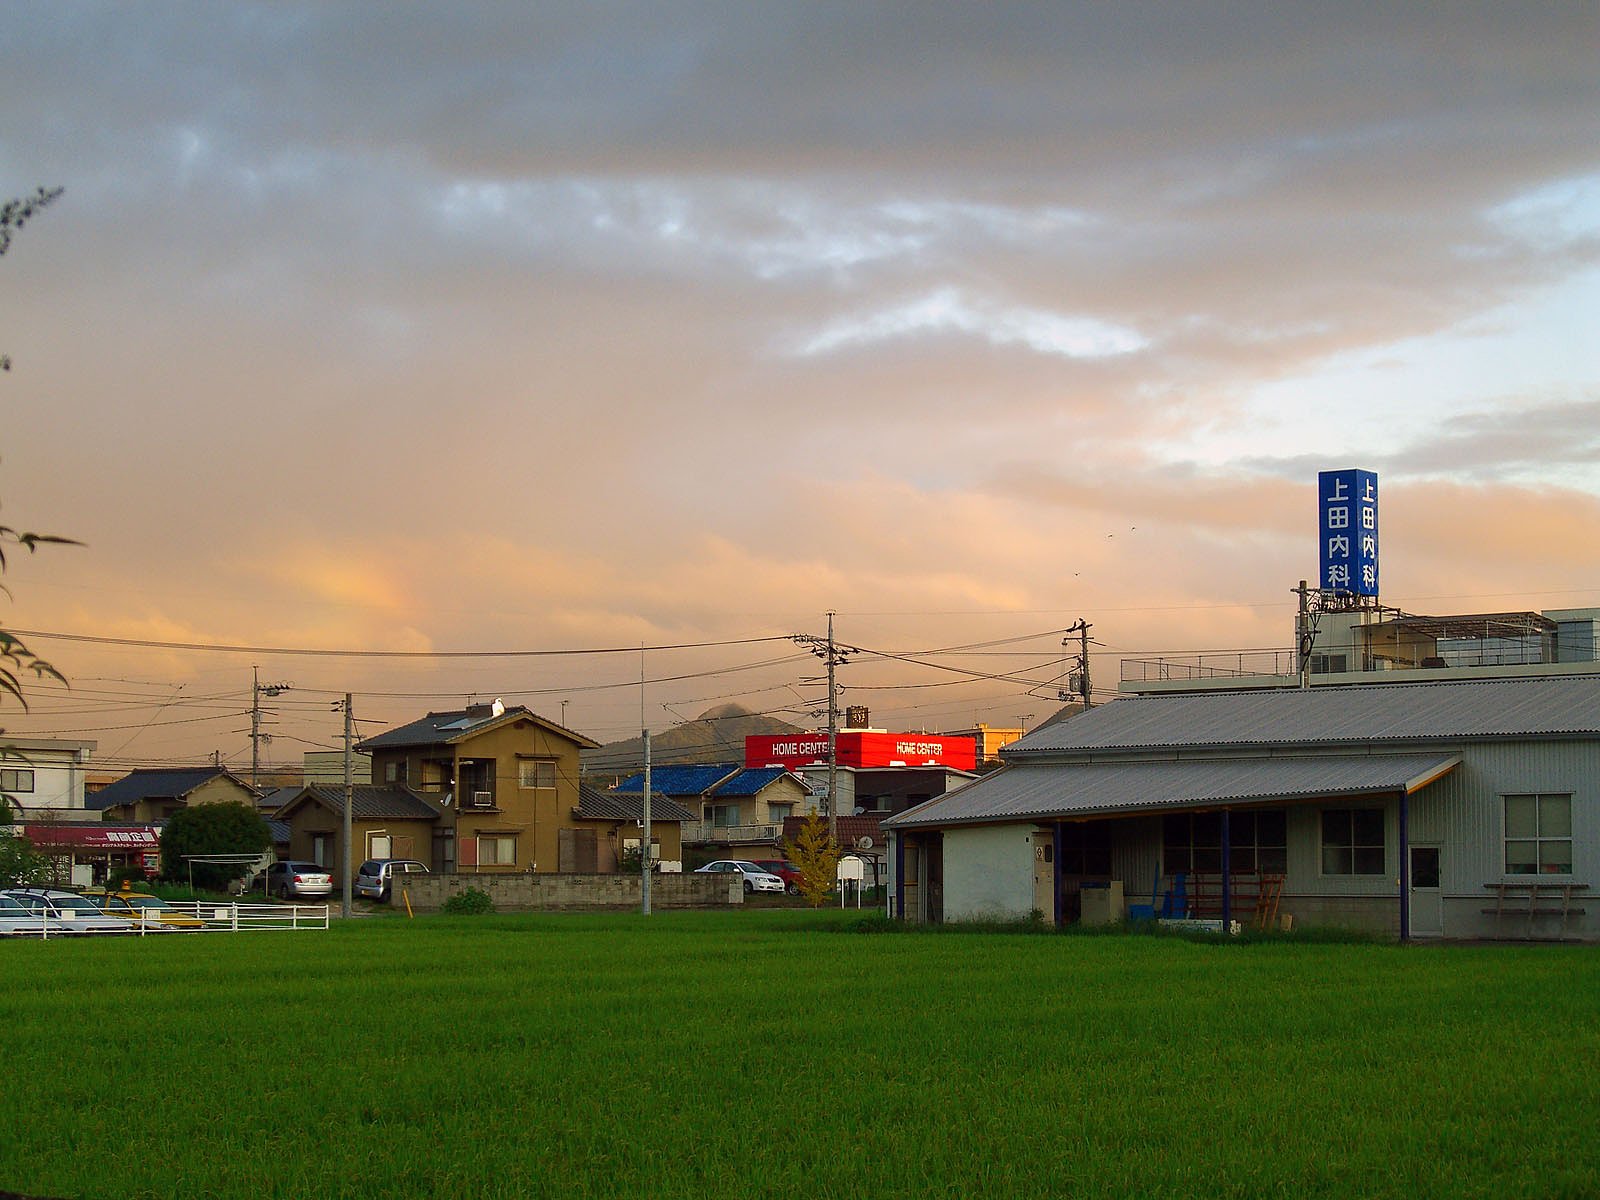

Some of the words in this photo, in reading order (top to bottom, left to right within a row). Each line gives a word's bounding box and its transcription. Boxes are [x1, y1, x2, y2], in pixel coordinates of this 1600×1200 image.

[1327, 478, 1350, 587] 上田内科
[1362, 478, 1375, 588] 上田内科
[772, 743, 798, 755] HOME
[799, 741, 830, 755] CENTE
[896, 741, 916, 755] HOME
[916, 743, 943, 756] CENTER
